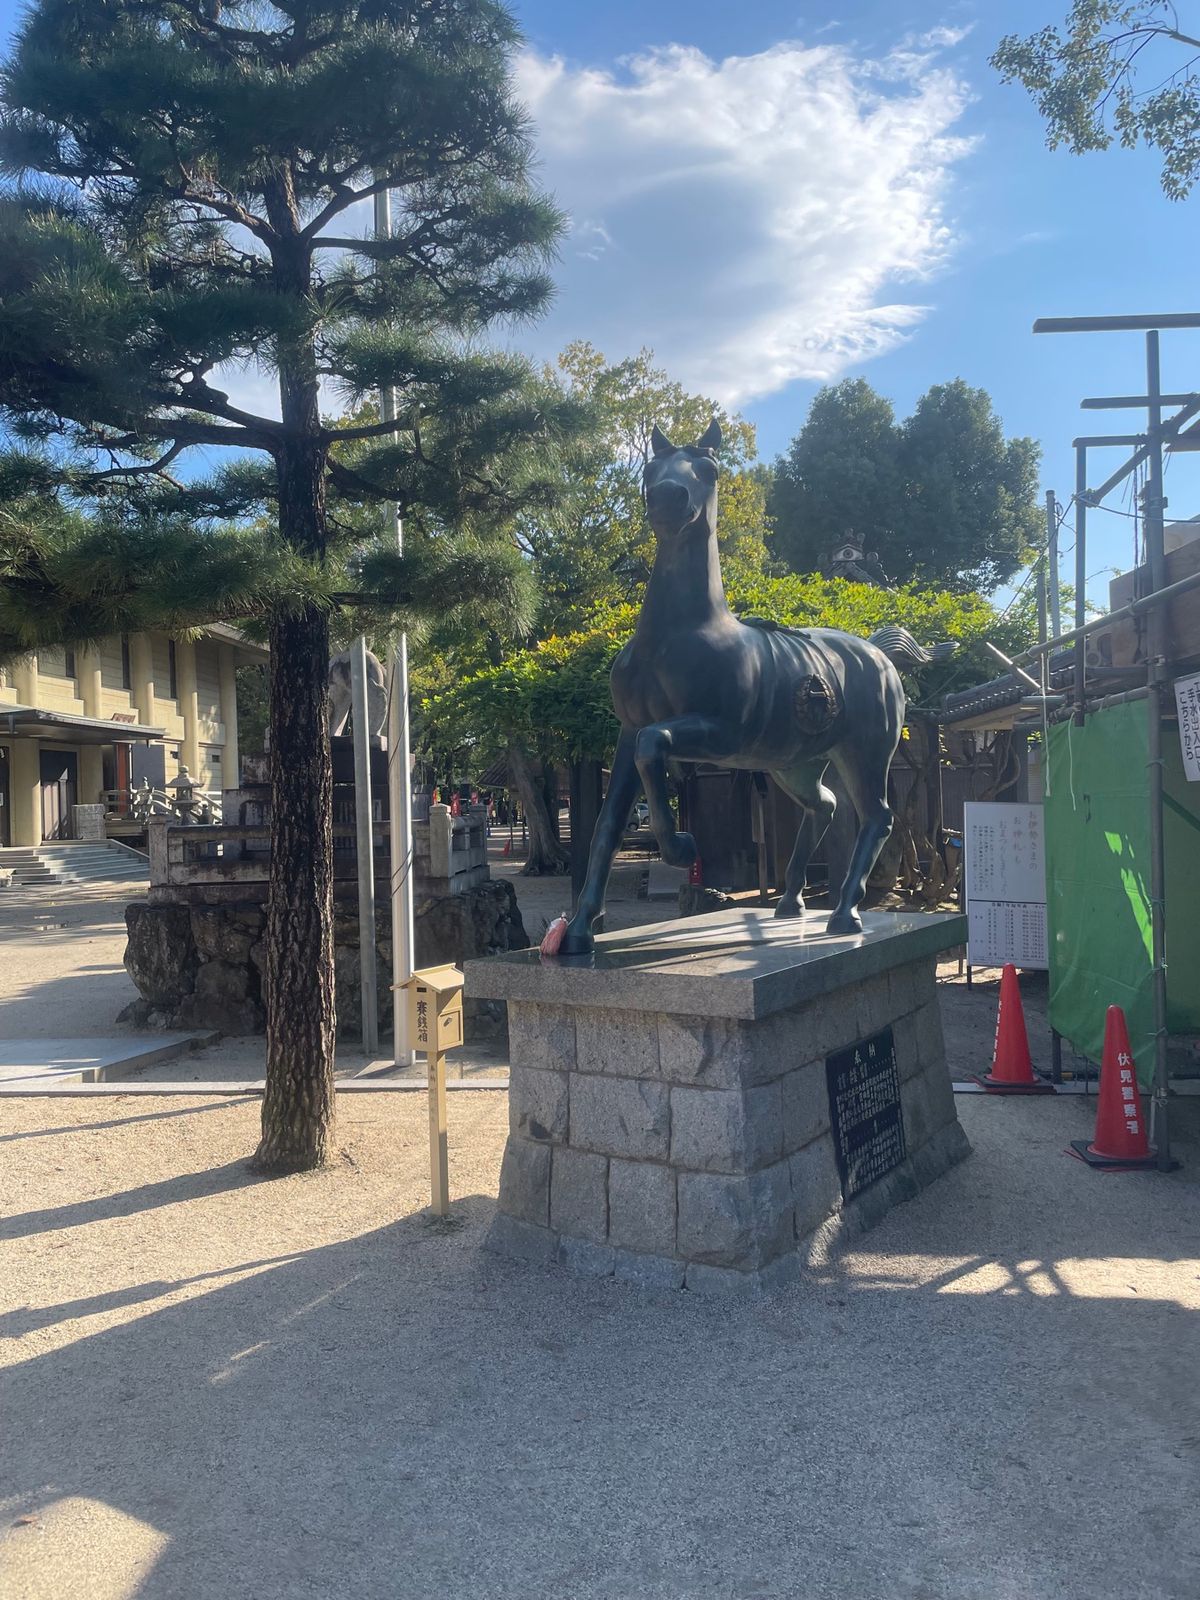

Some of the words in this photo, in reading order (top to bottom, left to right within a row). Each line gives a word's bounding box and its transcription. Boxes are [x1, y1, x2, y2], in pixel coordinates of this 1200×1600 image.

[1179, 691, 1194, 760] こちらから
[1187, 688, 1200, 773] 手水出入口
[416, 1000, 428, 1042] 賽銭箱
[1117, 1052, 1139, 1135] 伏見警察署
